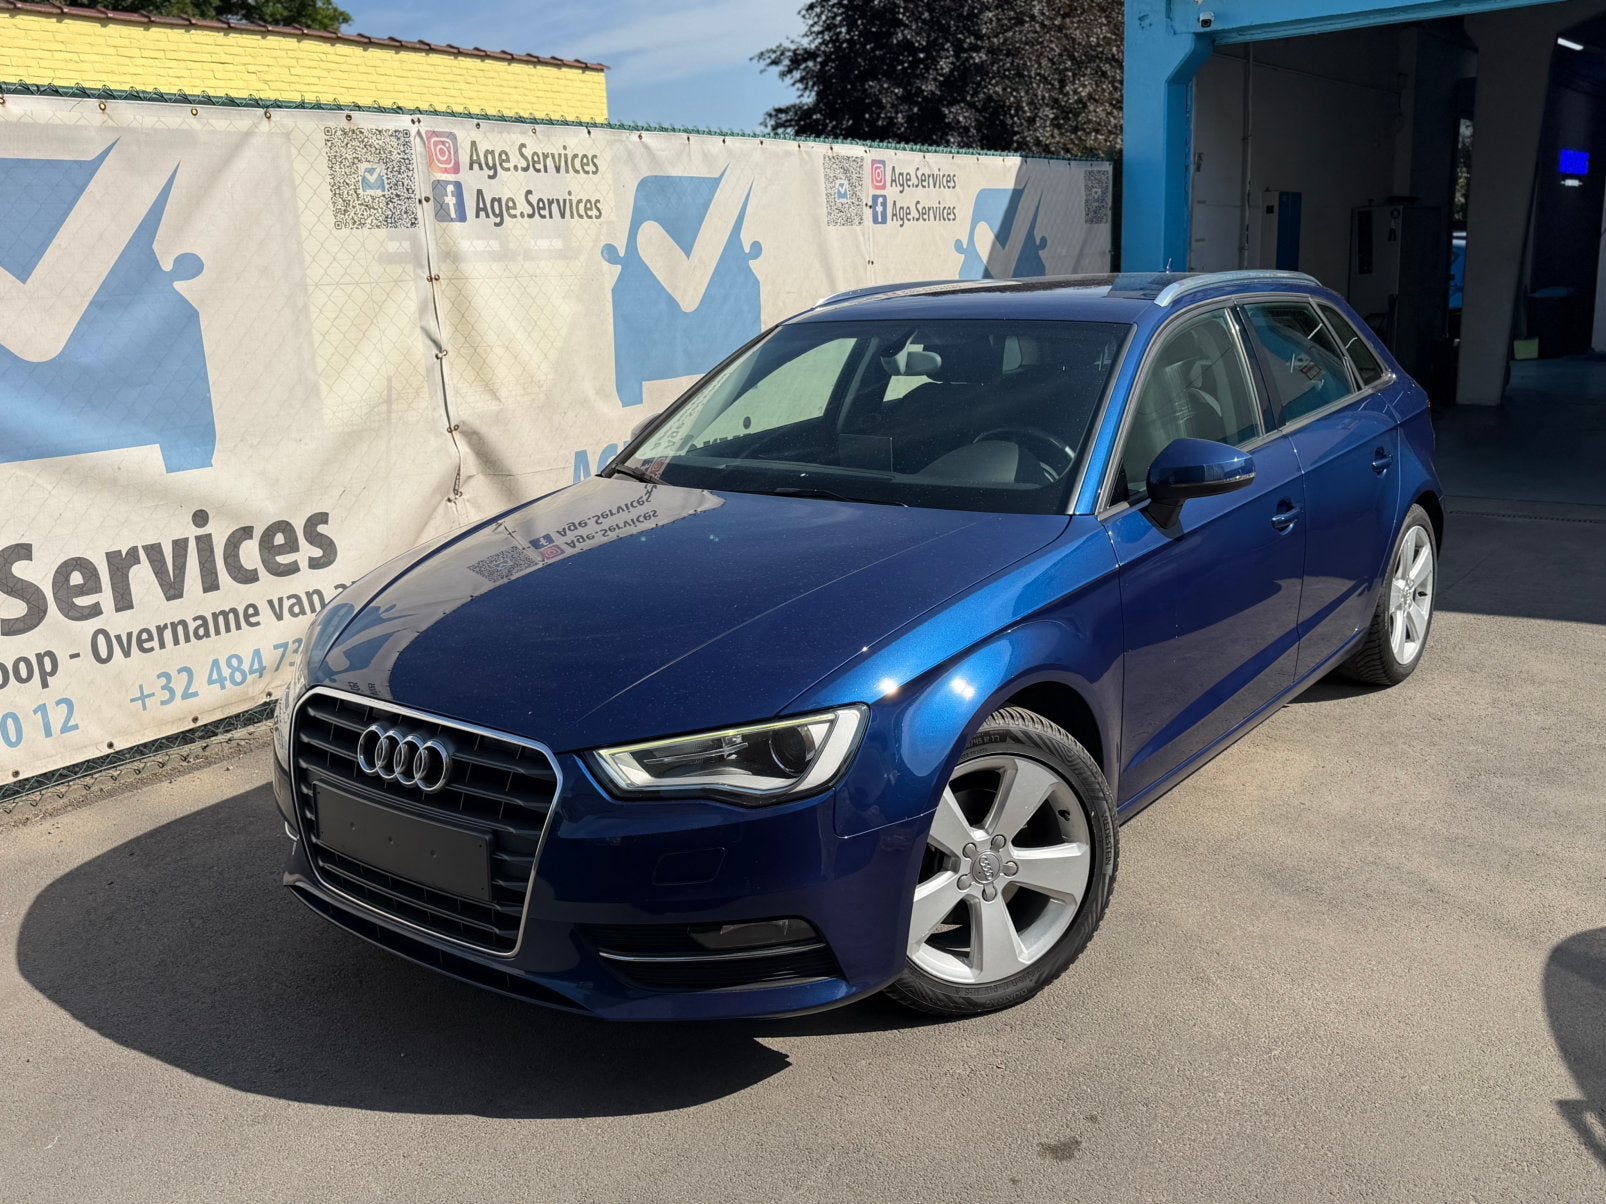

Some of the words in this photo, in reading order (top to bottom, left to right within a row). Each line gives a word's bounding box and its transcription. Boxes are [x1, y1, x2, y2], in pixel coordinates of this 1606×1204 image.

[468, 140, 599, 180] Age.Services
[890, 165, 957, 194] Age.Services
[475, 188, 603, 227] Age.Services
[891, 200, 957, 228] Age.Services
[0, 509, 338, 637] Services
[90, 602, 261, 665] Overname
[266, 588, 327, 622] van
[129, 665, 200, 712] +32
[206, 647, 267, 694] 484
[32, 697, 80, 738] 12
